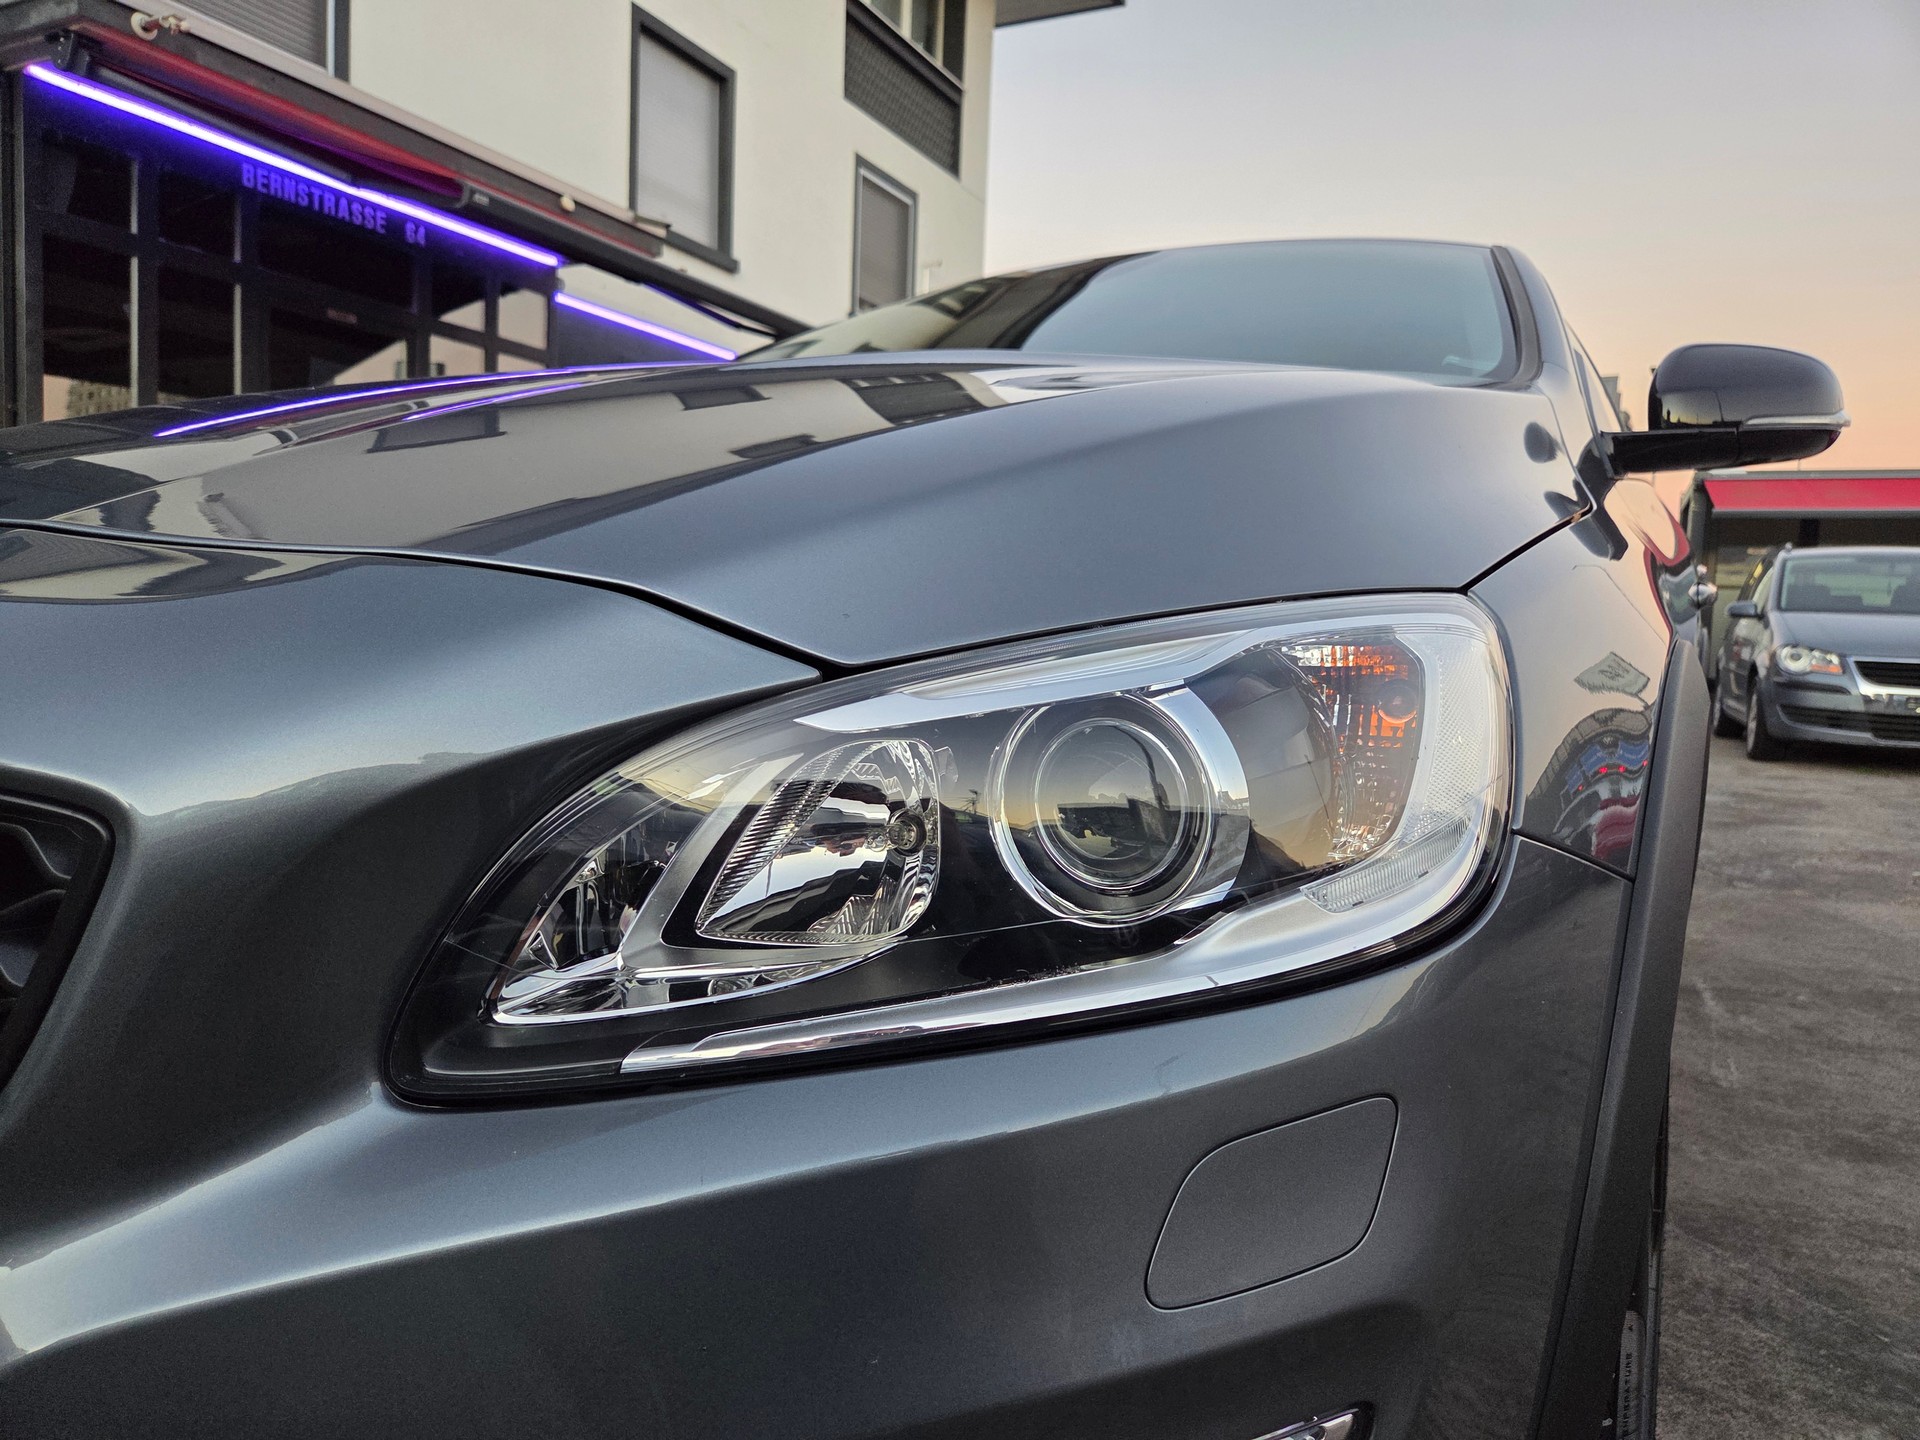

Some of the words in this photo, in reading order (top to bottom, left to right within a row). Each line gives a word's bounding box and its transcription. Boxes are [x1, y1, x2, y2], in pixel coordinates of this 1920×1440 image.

[241, 162, 388, 235] BERNSTRASSE
[405, 220, 427, 248] 64
[1622, 1353, 1633, 1439] EMPERATURE
